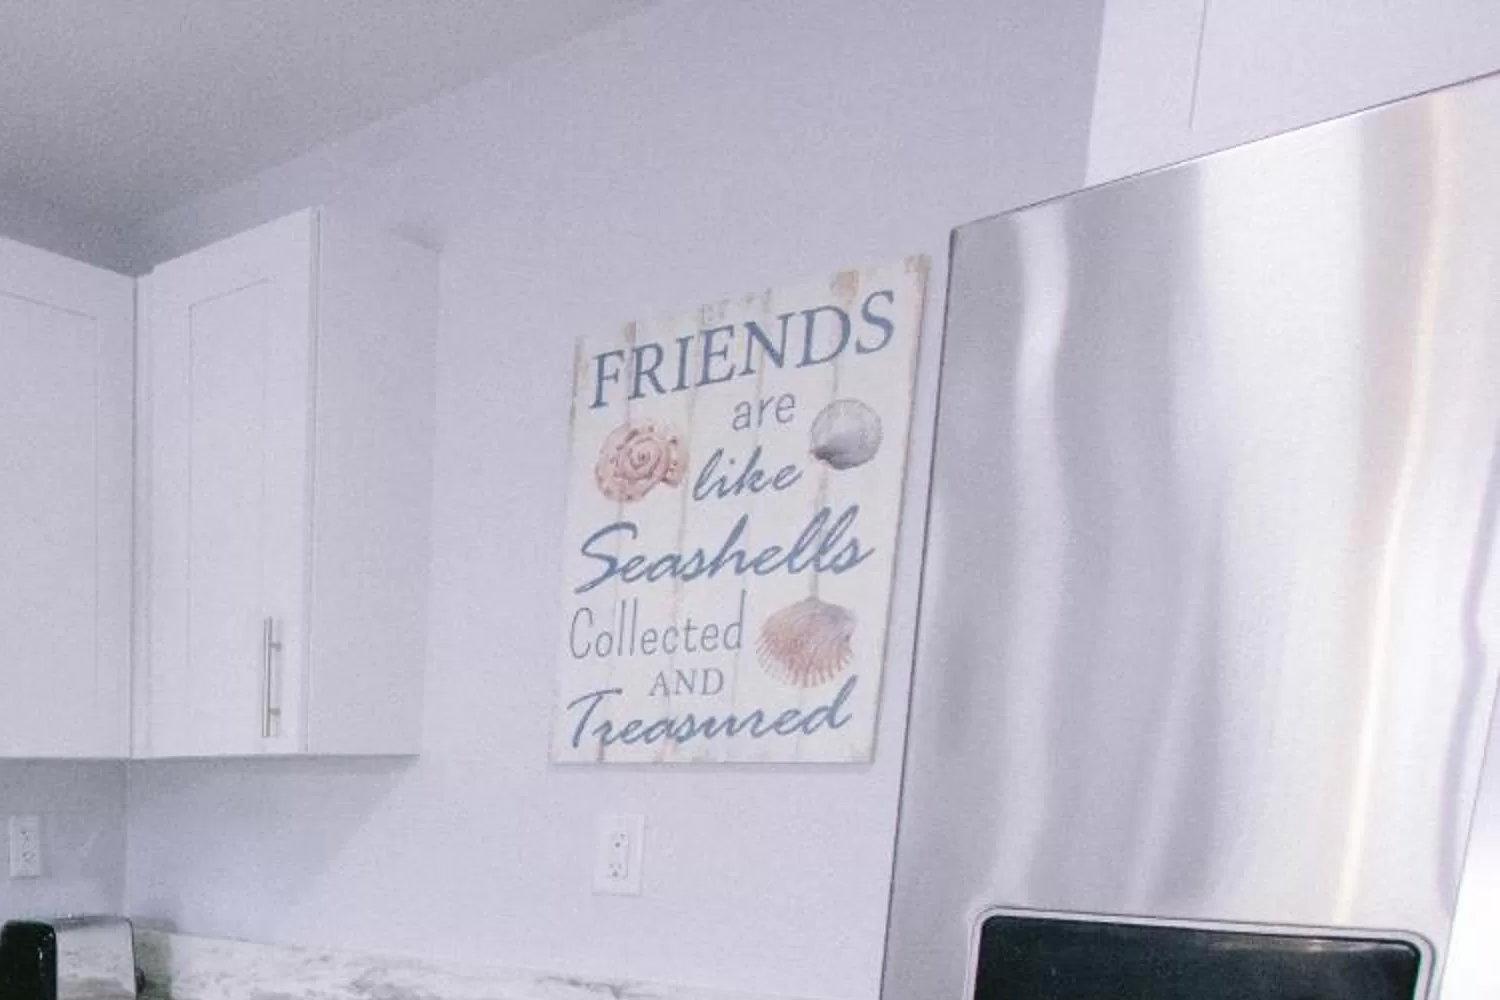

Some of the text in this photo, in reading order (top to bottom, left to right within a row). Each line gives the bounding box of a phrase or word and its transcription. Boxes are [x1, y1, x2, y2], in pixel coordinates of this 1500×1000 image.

[589, 290, 895, 408] FRIENDS
[732, 392, 797, 430] are
[692, 448, 803, 501] like
[575, 505, 875, 594] Seashells
[569, 590, 747, 659] Collected
[566, 676, 858, 748] Treasured
[648, 668, 725, 697] AND
